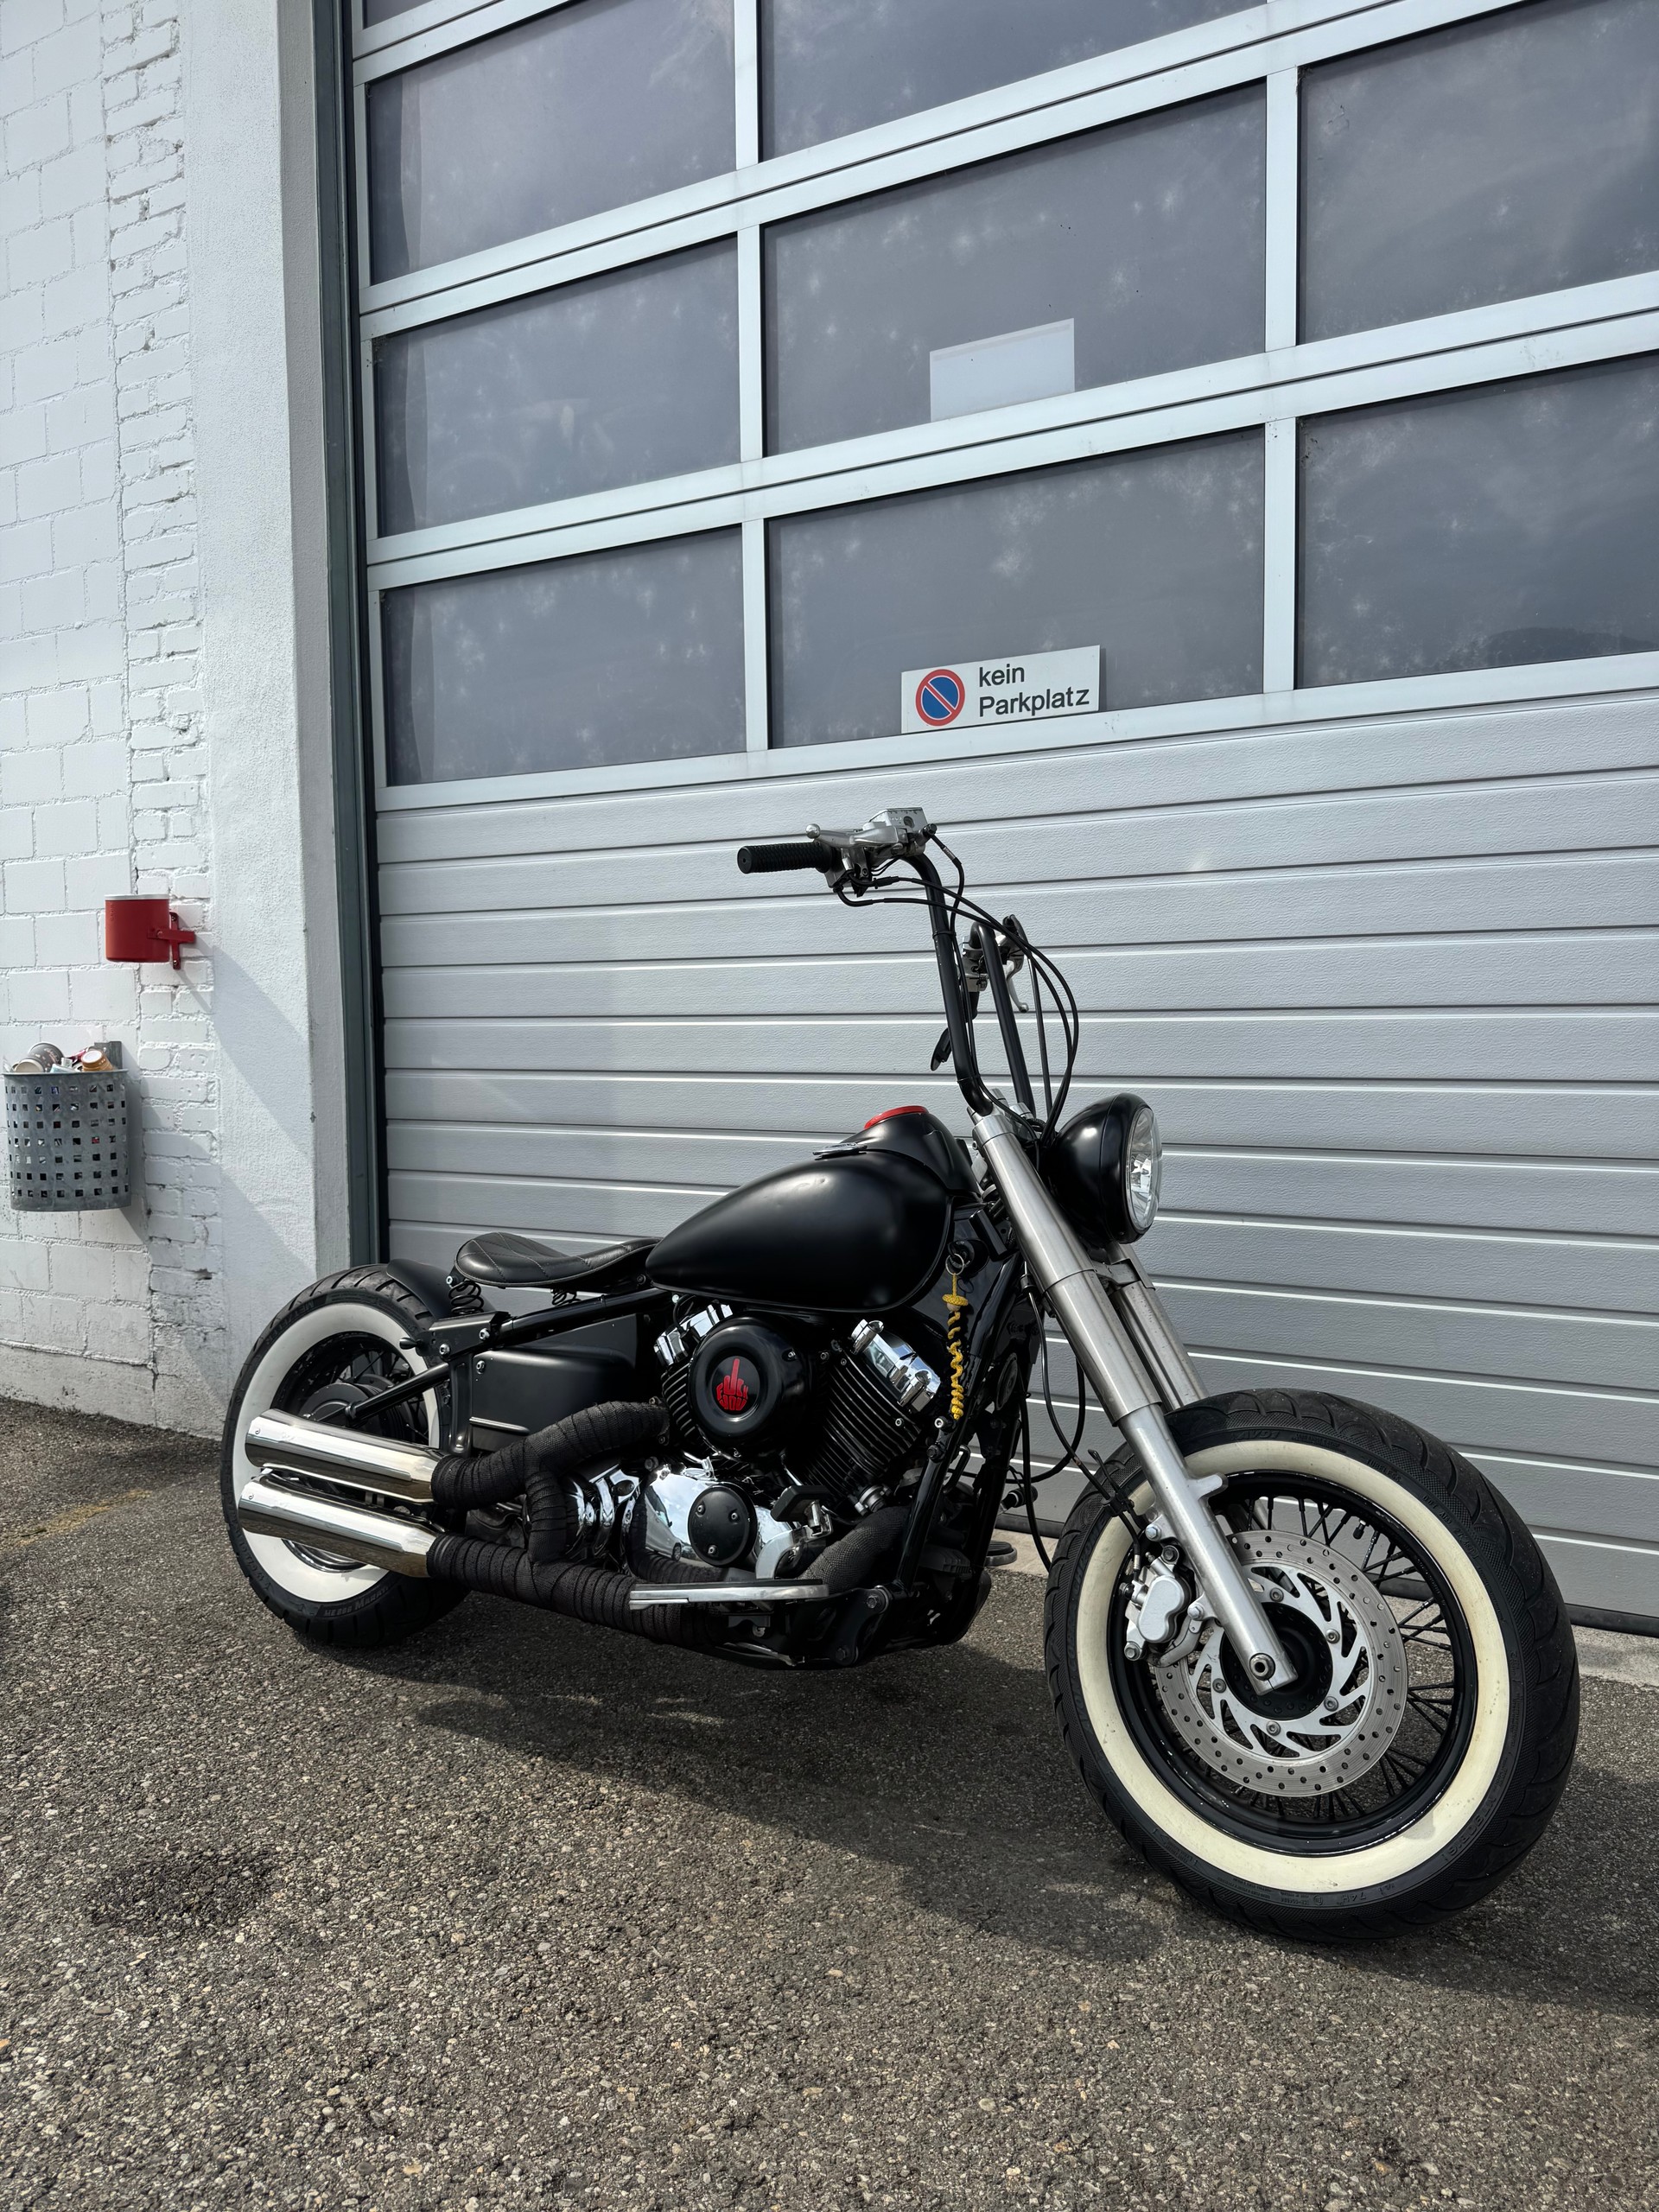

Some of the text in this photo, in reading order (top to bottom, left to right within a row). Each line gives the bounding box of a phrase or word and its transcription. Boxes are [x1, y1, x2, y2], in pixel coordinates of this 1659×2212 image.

[979, 664, 1025, 687] kein
[979, 686, 1090, 717] Parkplatz
[716, 1358, 748, 1401] FUCK
[719, 1395, 747, 1410] YOU
